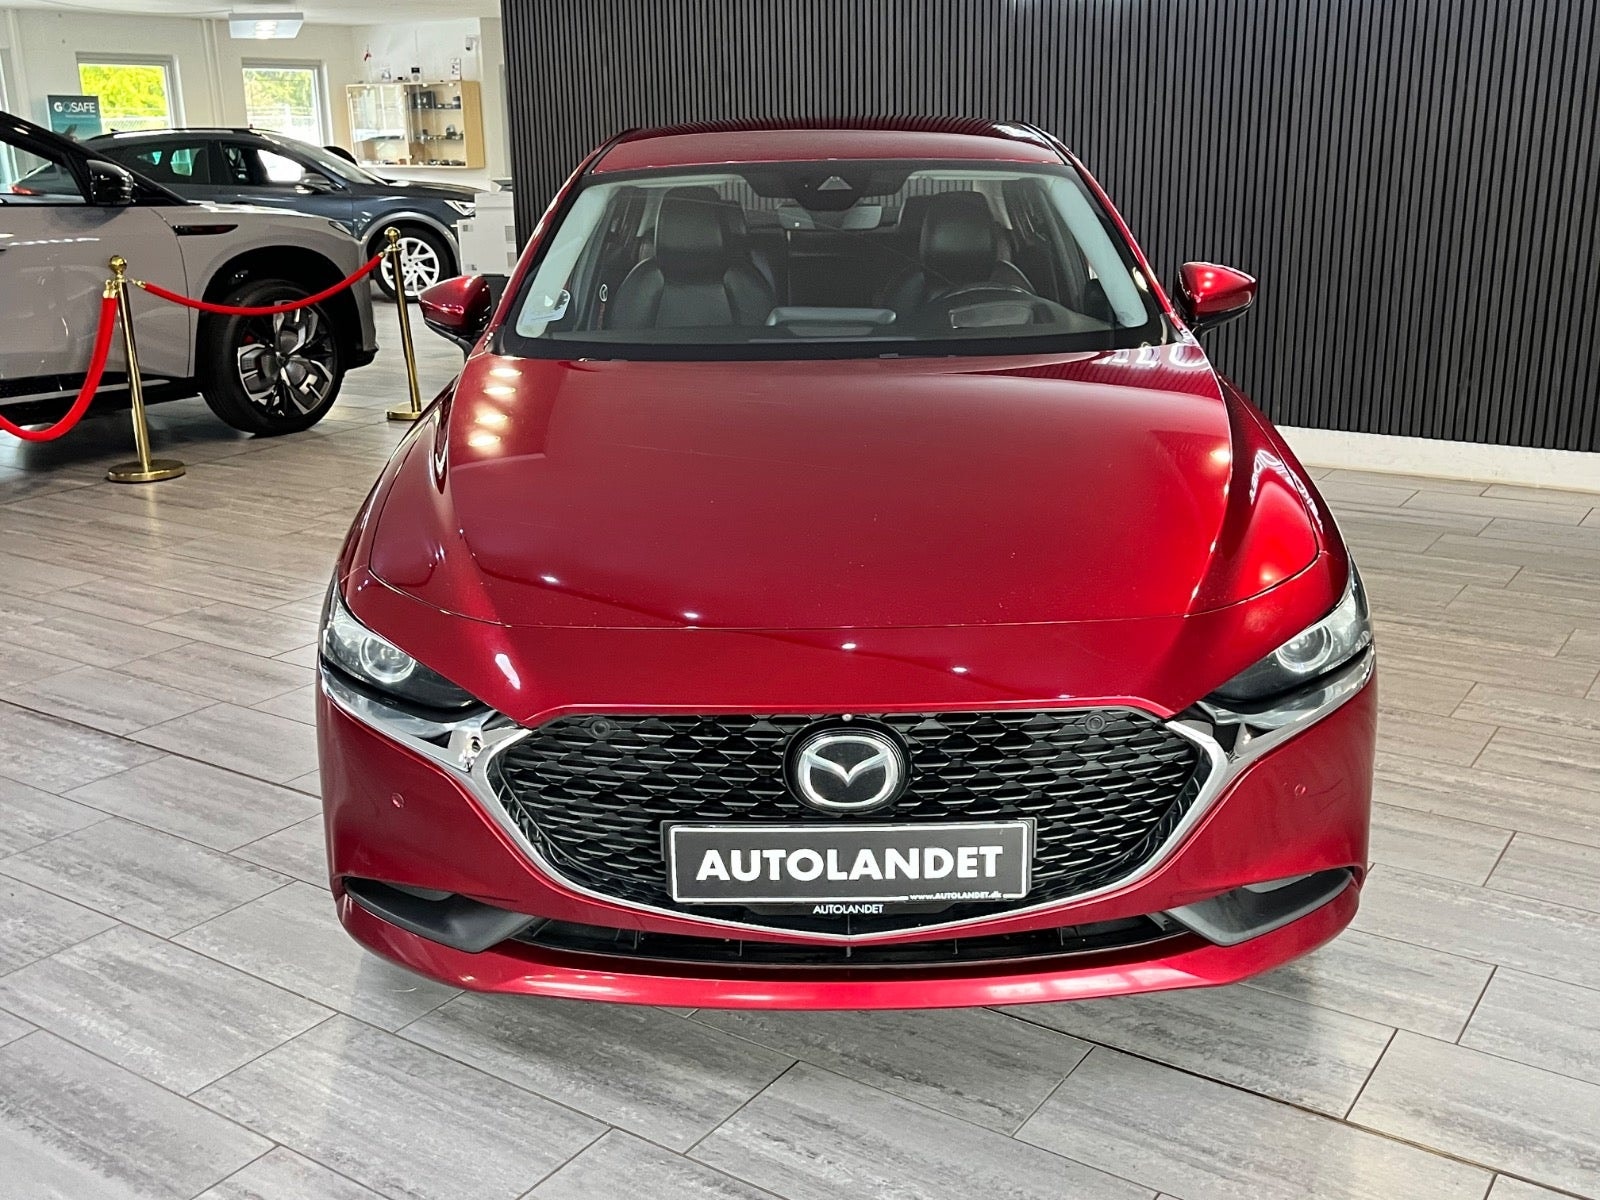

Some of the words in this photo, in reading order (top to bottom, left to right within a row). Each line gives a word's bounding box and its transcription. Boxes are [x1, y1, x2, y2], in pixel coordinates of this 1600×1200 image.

[53, 101, 96, 113] GOSAFE
[695, 845, 1004, 882] AUTOLANDET
[909, 890, 1002, 901] www.AUTOLANDET.dk
[812, 903, 884, 915] AUTOLANDET
